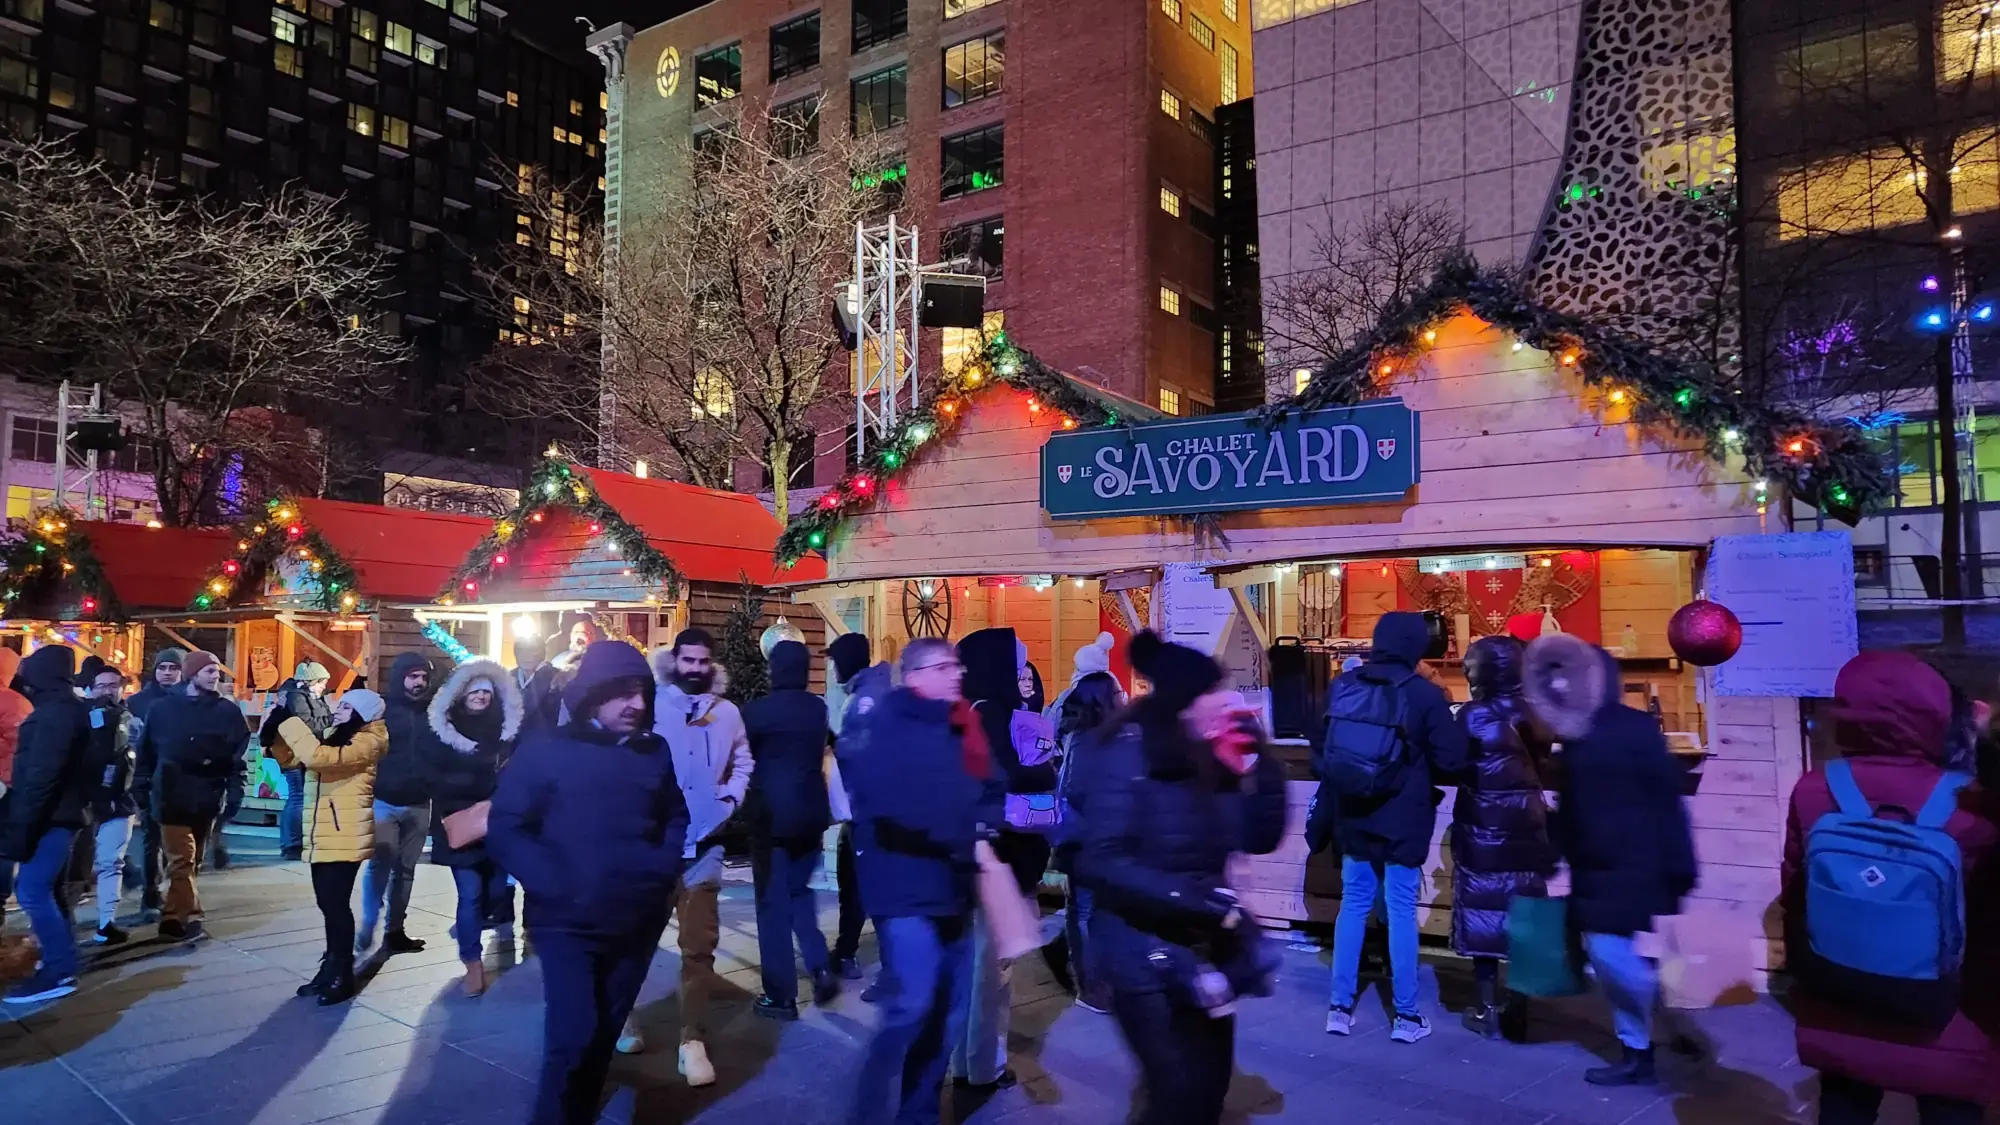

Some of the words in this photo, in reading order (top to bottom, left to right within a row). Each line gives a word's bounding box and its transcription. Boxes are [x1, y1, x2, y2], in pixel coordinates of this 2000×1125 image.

[1080, 466, 1093, 478] LE
[1093, 424, 1370, 499] SAVOYARD
[1166, 433, 1256, 456] CHALET
